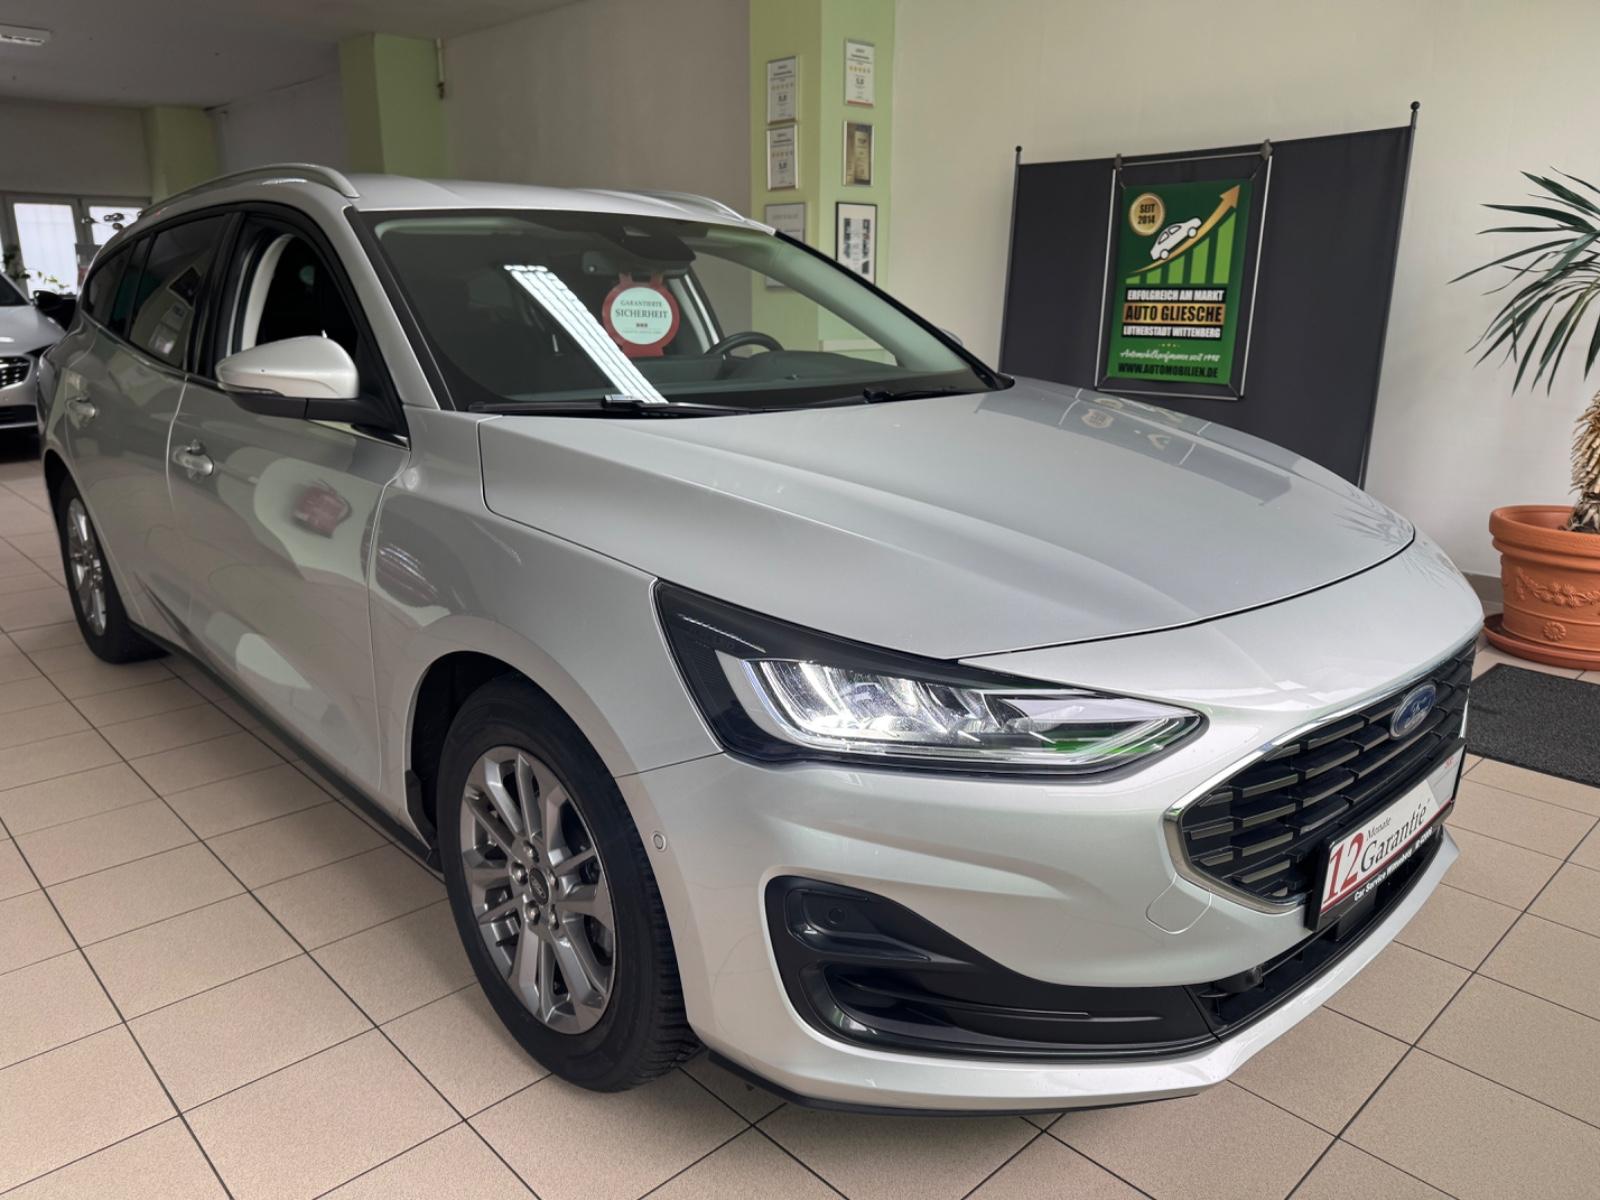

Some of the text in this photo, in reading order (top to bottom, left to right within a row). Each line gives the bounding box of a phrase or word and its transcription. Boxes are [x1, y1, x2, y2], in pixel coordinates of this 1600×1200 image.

[1140, 204, 1155, 213] SEIT
[1138, 215, 1155, 224] 2014
[1127, 289, 1224, 301] ERFOLGREICH AM MARKT
[615, 309, 668, 318] SICHERHEIT
[1125, 305, 1222, 322] AUTO GLIESCHE
[1123, 325, 1220, 338] LUTHERSTADT WITTENBERG
[1366, 817, 1391, 840] Monate
[1324, 832, 1364, 904] 12
[1354, 888, 1365, 901] Car
[1365, 871, 1387, 893] Service
